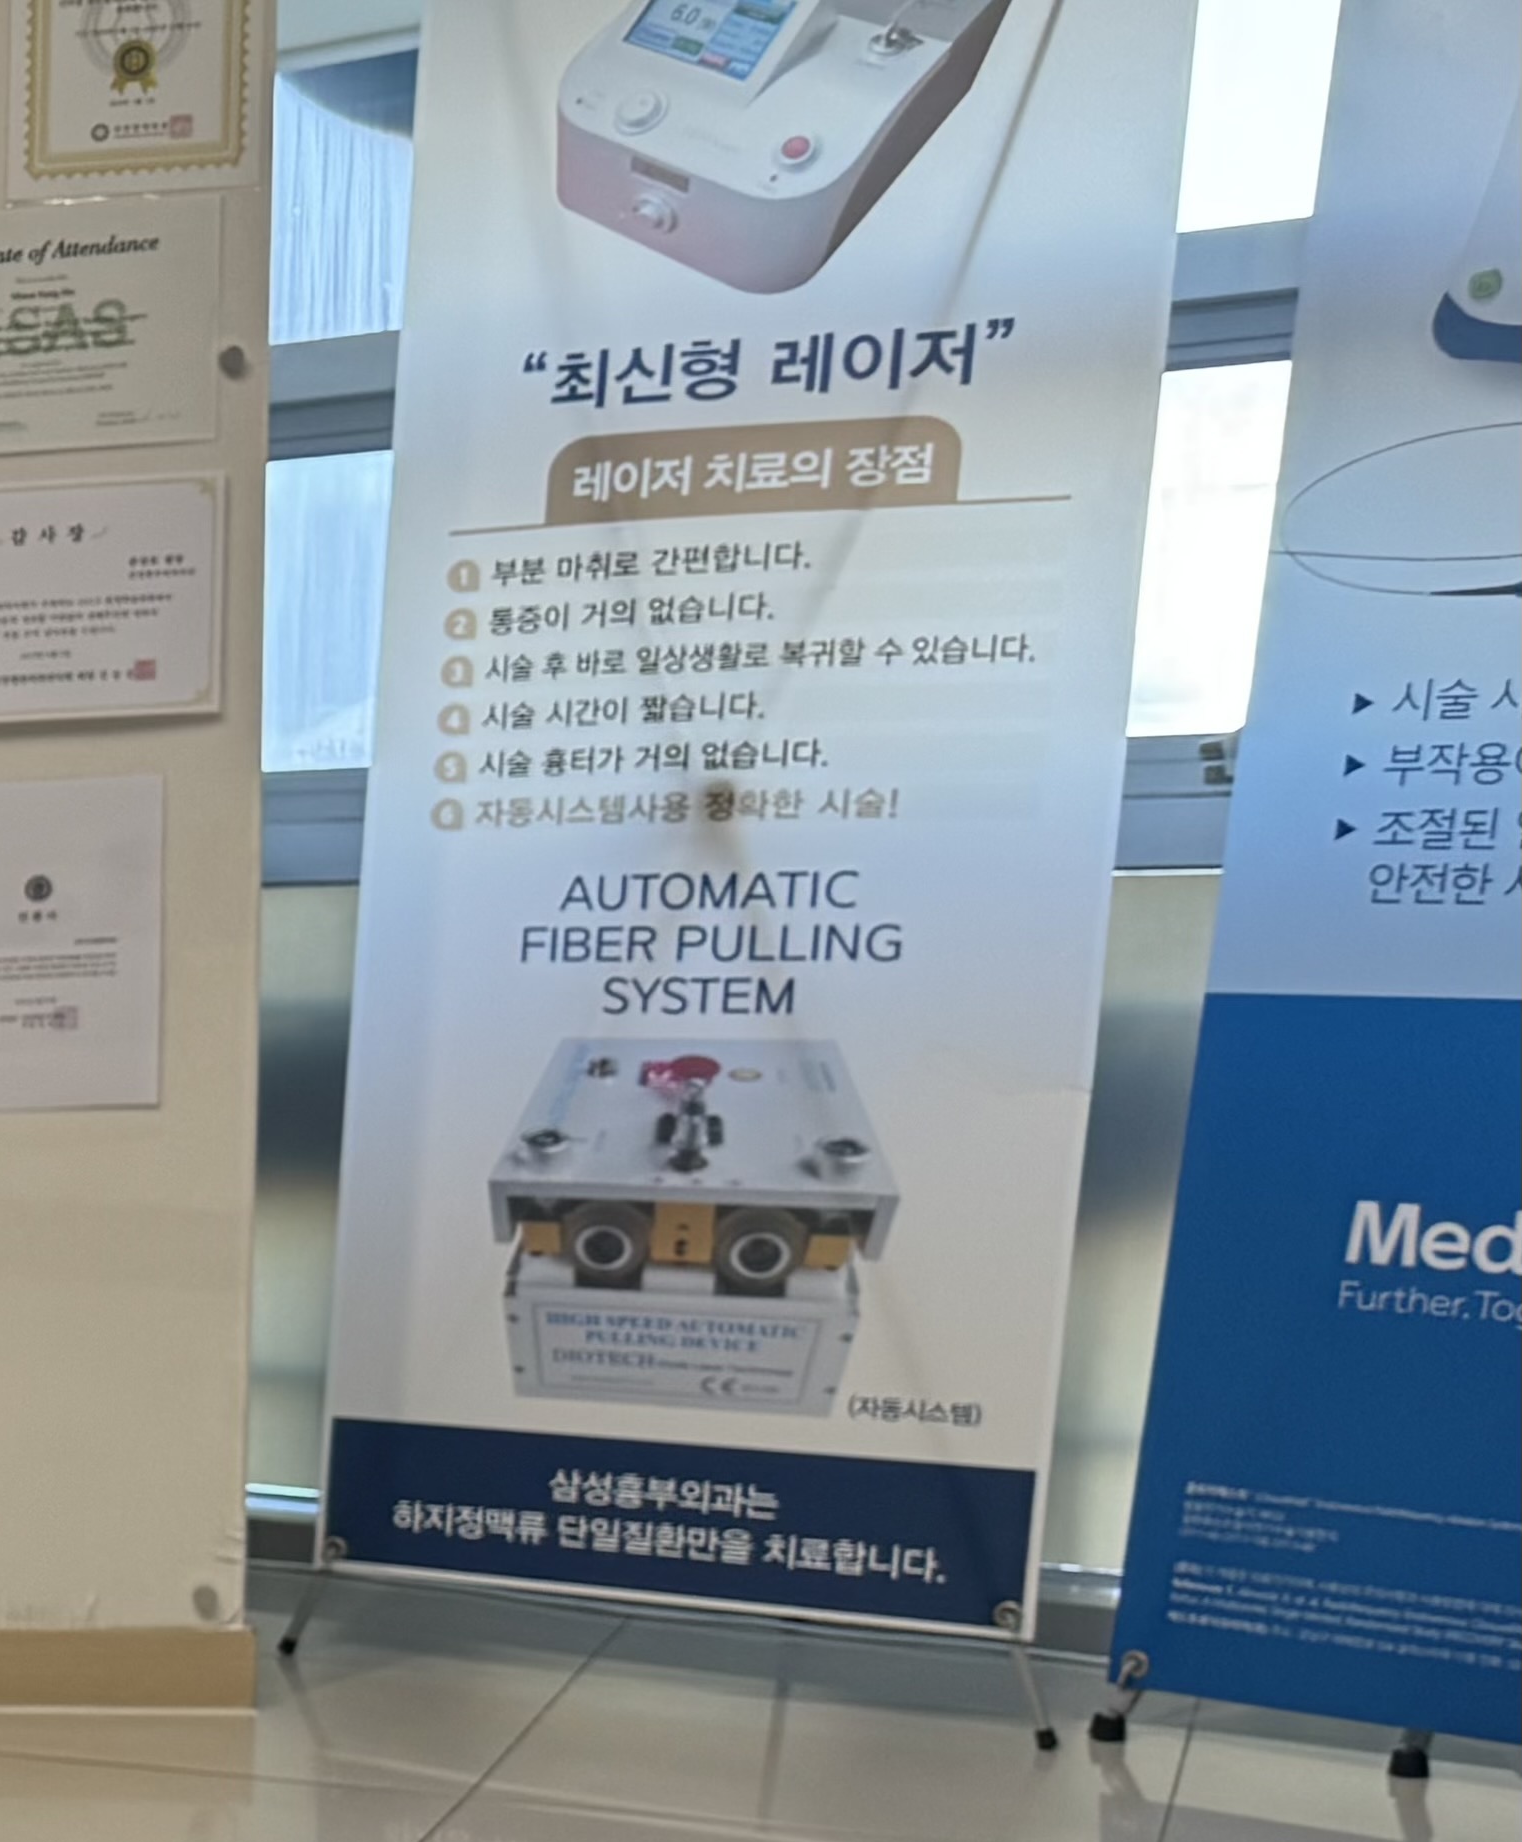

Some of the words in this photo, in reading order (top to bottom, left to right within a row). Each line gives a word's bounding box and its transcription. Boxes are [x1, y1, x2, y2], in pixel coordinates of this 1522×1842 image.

[28, 240, 53, 266] of
[51, 235, 160, 259] Attendance
[572, 453, 693, 502] 레이저
[703, 447, 833, 493] 치료의
[845, 443, 935, 488] 장점
[491, 556, 546, 586] 부분
[556, 551, 640, 581] 마취로
[652, 541, 811, 577] 간편합니다.
[488, 603, 570, 636] 통증이
[581, 598, 637, 629] 거의
[648, 592, 775, 626] 없습니다.
[485, 654, 535, 683] 시술
[542, 651, 568, 681] 후
[576, 648, 627, 677] 바로
[635, 641, 770, 676] 일상생활로
[779, 636, 866, 668] 복귀할
[873, 638, 904, 666] 수
[911, 633, 1036, 666] 있습니다.
[481, 701, 535, 731] 시술
[546, 695, 629, 727] 시간이
[639, 690, 766, 724] 짧습니다.
[1392, 678, 1479, 722] 시술
[478, 750, 532, 779] 시술
[541, 744, 625, 778] 흉터가
[635, 741, 690, 771] 거의
[701, 738, 828, 771] 없습니다.
[475, 790, 690, 829] 자동시스템사용
[818, 786, 900, 820] 시술!
[1372, 807, 1499, 851] 조절된
[559, 870, 860, 912] AUTOMATIC
[1369, 861, 1494, 906] 안전한
[520, 924, 656, 963] FIBER
[675, 922, 903, 963] PULLING
[602, 976, 796, 1016] SYSTEM
[606, 1313, 673, 1331] SPEED
[676, 1318, 800, 1340] AUTOMATIC
[1337, 1279, 1471, 1320] Further.
[1473, 1289, 1522, 1331] To
[584, 1329, 676, 1349] PULLING
[679, 1335, 763, 1353] DEVICE
[548, 1468, 780, 1521] 삼성흉부외과는
[391, 1499, 549, 1545] 하지정맥류
[556, 1513, 754, 1566] 단일질환만을
[761, 1532, 948, 1585] 치료합니다.
